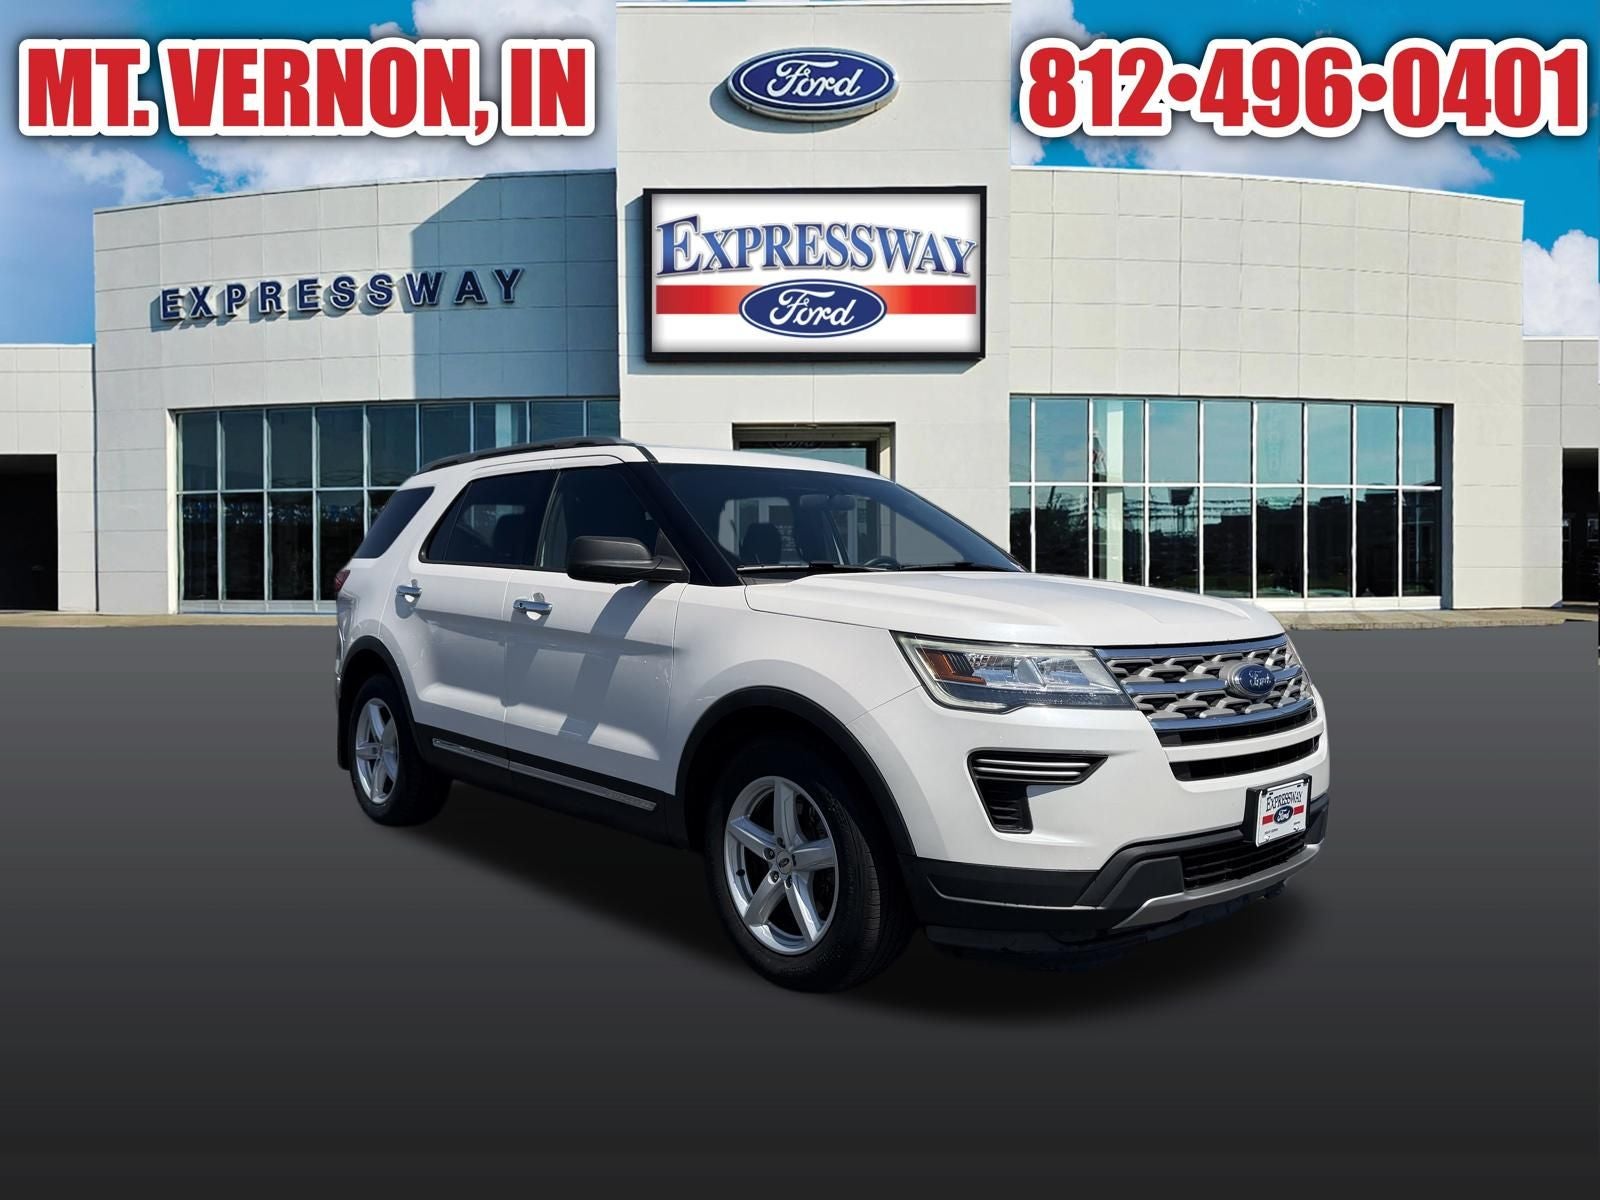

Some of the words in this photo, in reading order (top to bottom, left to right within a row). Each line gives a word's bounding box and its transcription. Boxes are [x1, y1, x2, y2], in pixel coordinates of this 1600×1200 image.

[766, 58, 862, 98] Ford
[655, 214, 977, 277] EXPRESSWAY
[159, 267, 526, 322] EXPRESSWAY
[769, 289, 855, 326] Ford
[1249, 670, 1272, 688] Ford
